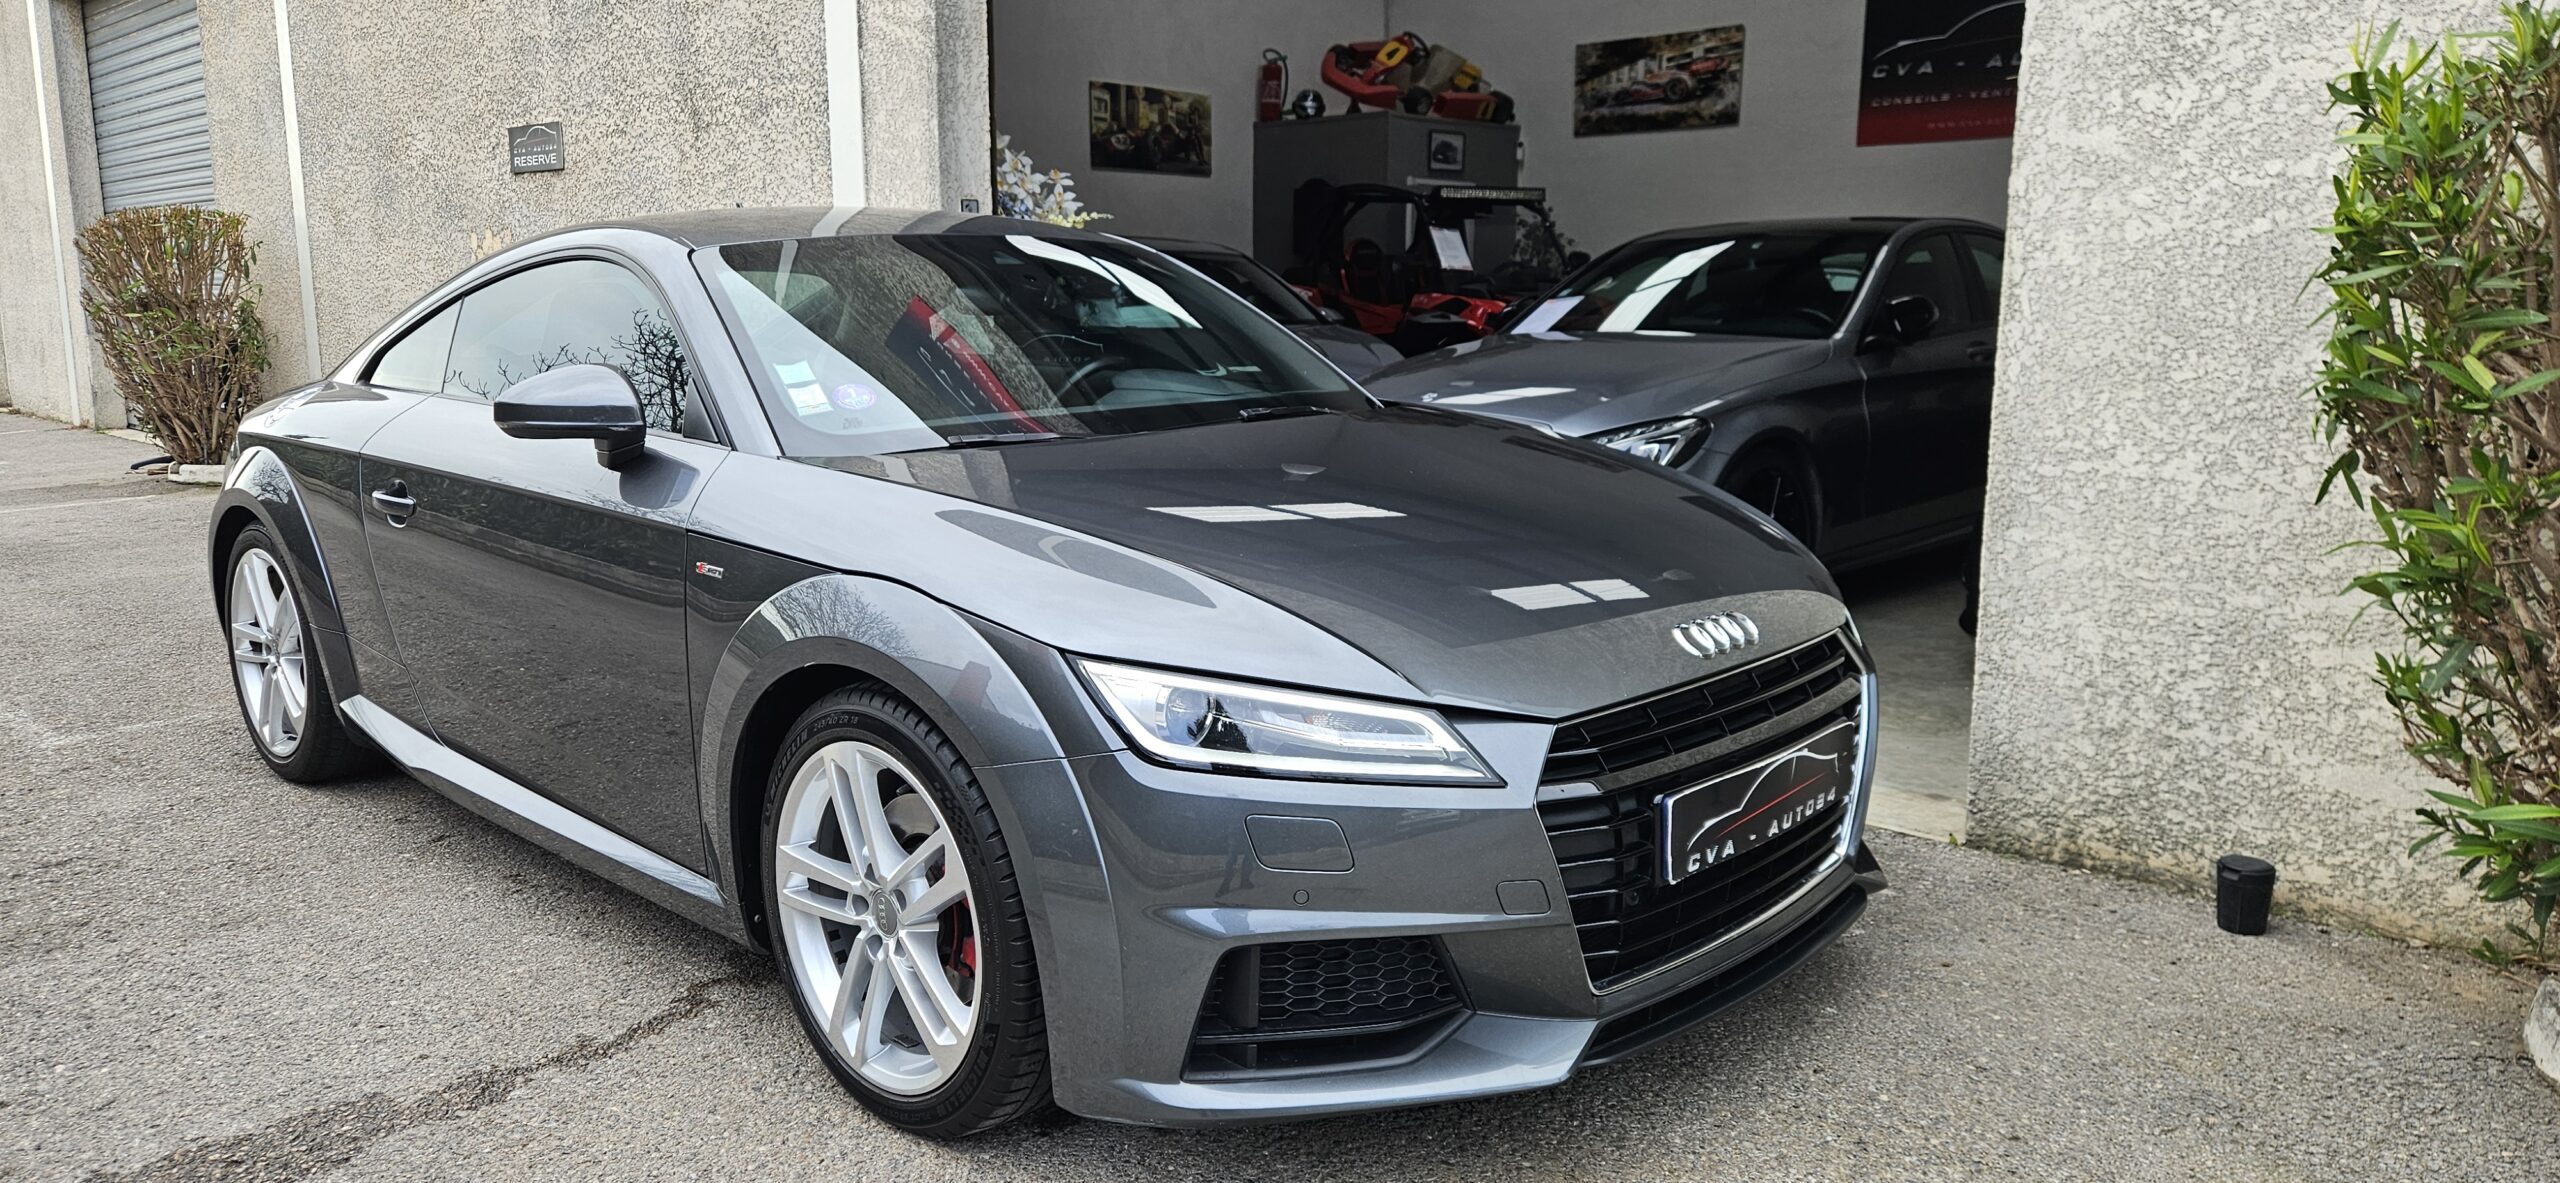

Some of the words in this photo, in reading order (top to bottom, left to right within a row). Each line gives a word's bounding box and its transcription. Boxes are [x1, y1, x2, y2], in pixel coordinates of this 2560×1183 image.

[1872, 59, 1934, 79] CVA
[514, 153, 557, 168] RESERVE
[770, 729, 808, 800] MICHELIN
[1686, 839, 1735, 873] CVA
[1768, 786, 1836, 838] AUTO34
